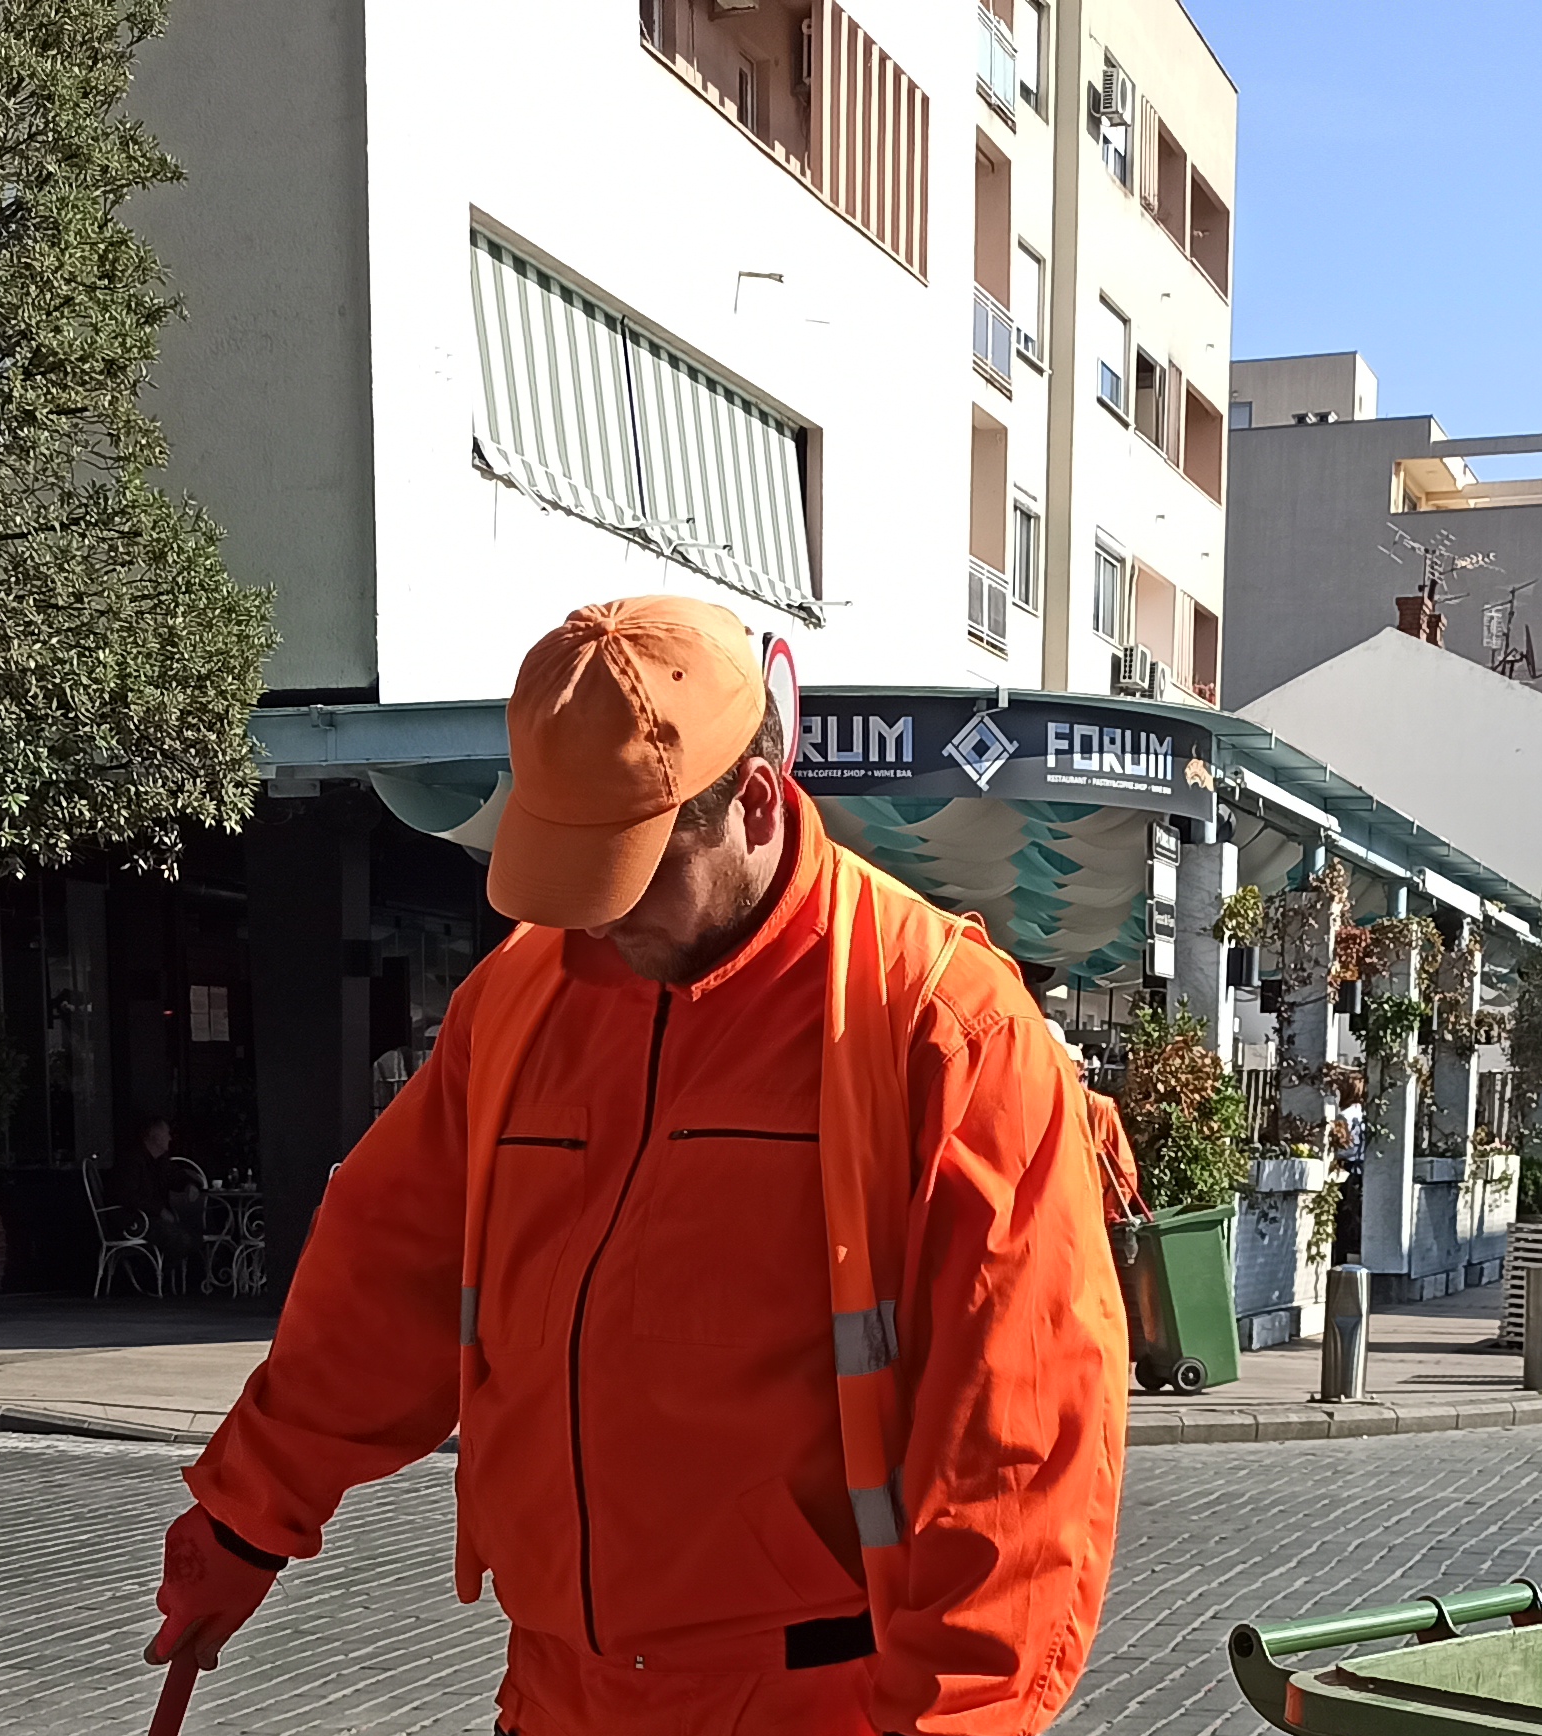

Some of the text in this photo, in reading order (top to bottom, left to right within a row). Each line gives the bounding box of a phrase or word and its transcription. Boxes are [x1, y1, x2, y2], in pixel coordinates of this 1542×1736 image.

[796, 716, 913, 762] RUM
[1047, 722, 1172, 780] FORUM
[794, 769, 842, 777] TRY&COFFEE
[843, 769, 865, 777] SHOP
